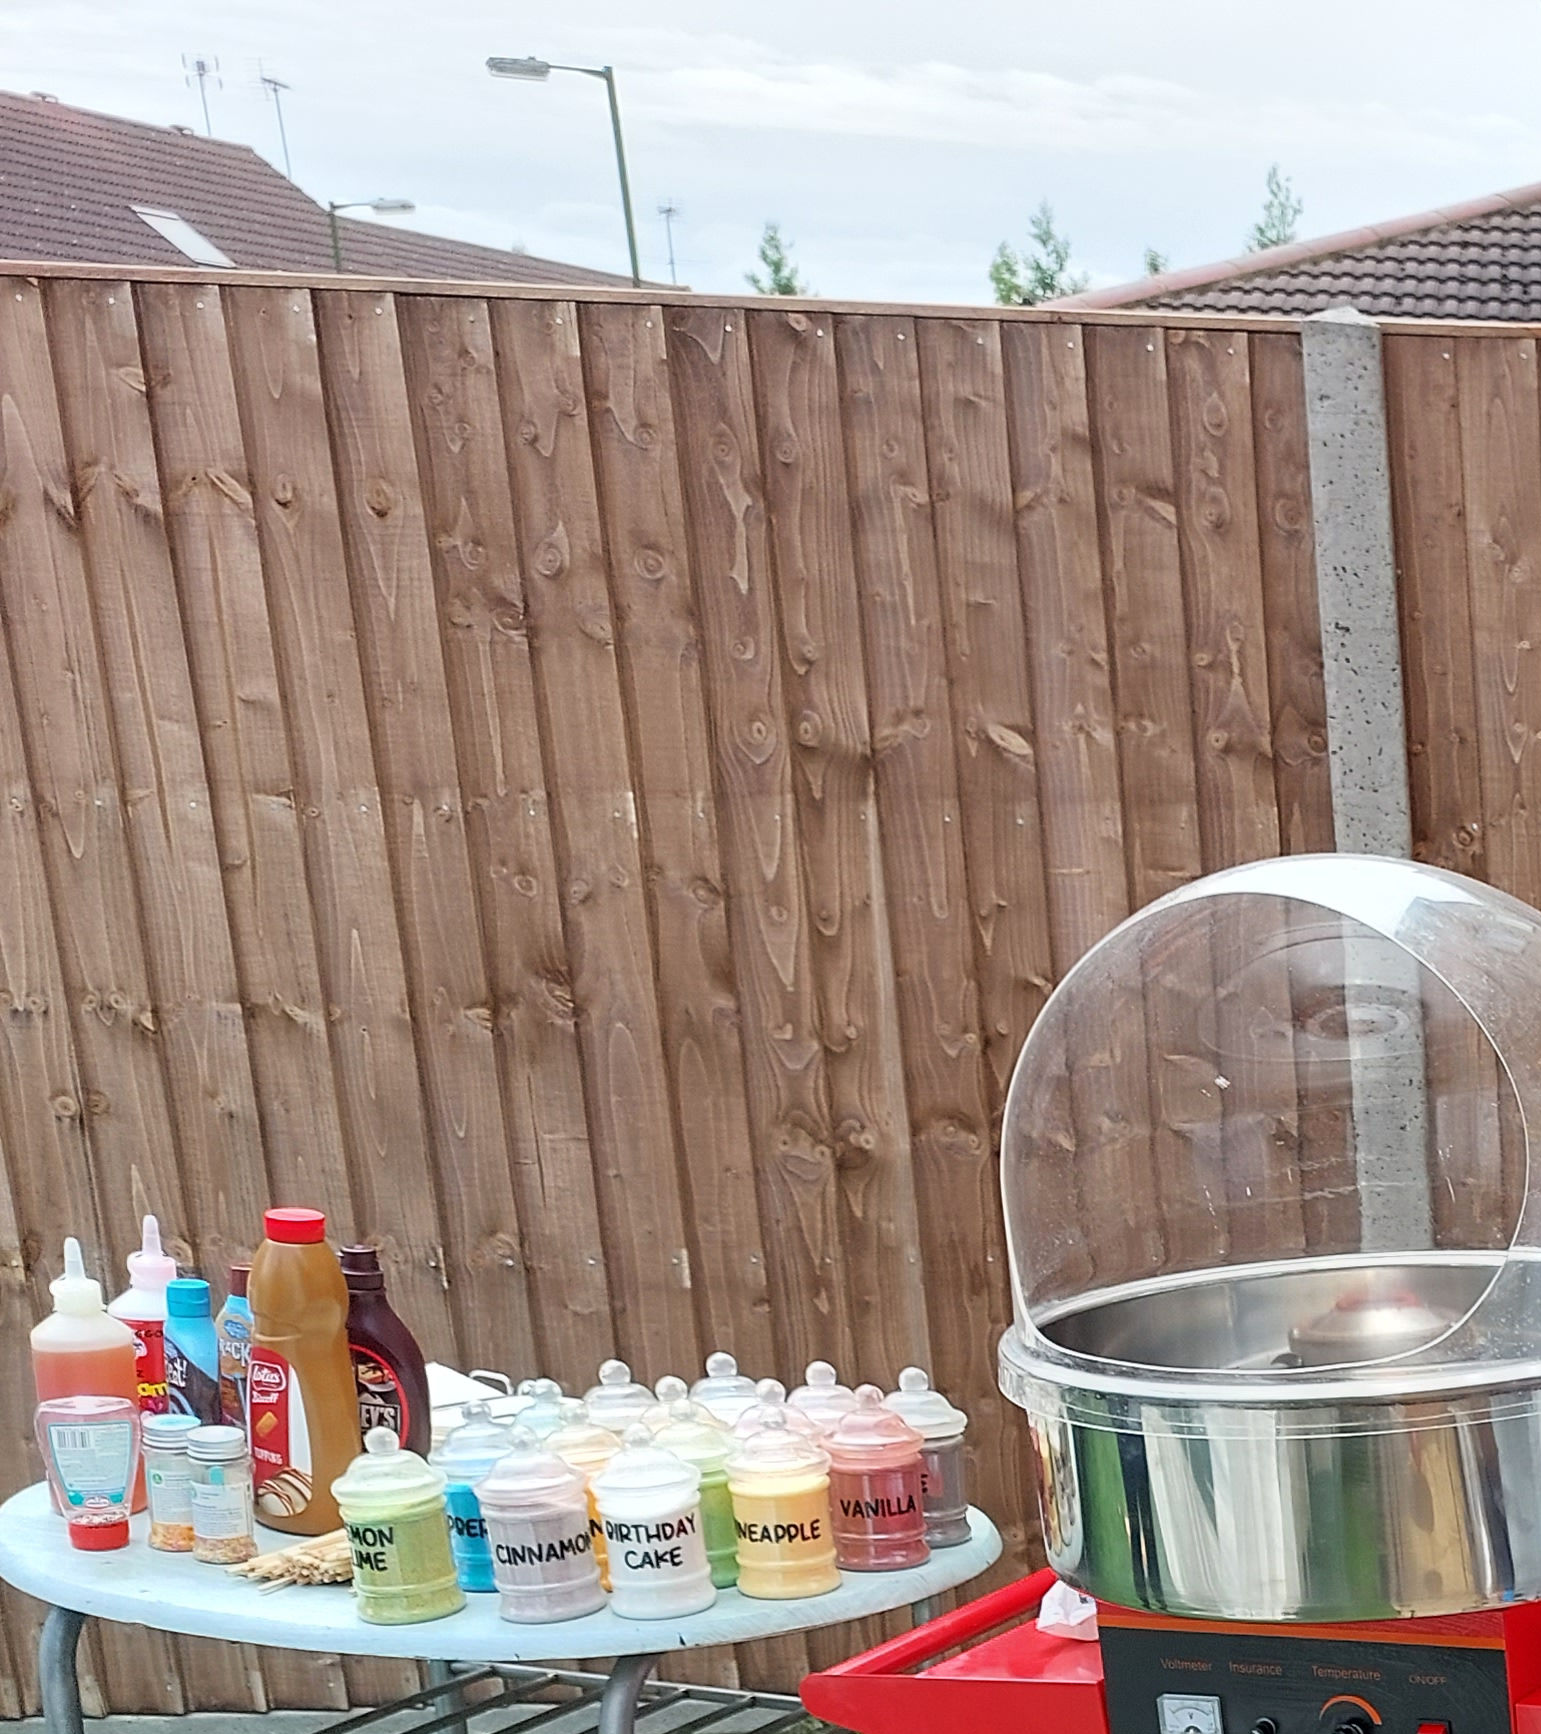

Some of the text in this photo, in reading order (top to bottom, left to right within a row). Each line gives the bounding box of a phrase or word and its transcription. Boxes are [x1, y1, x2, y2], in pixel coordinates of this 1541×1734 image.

[840, 1494, 918, 1519] VANILLA
[605, 1512, 697, 1545] BIRTHDAY
[624, 1547, 684, 1571] CAKE
[1160, 1658, 1448, 1686] Voltmeter Insurance Temperature ON/OFF
